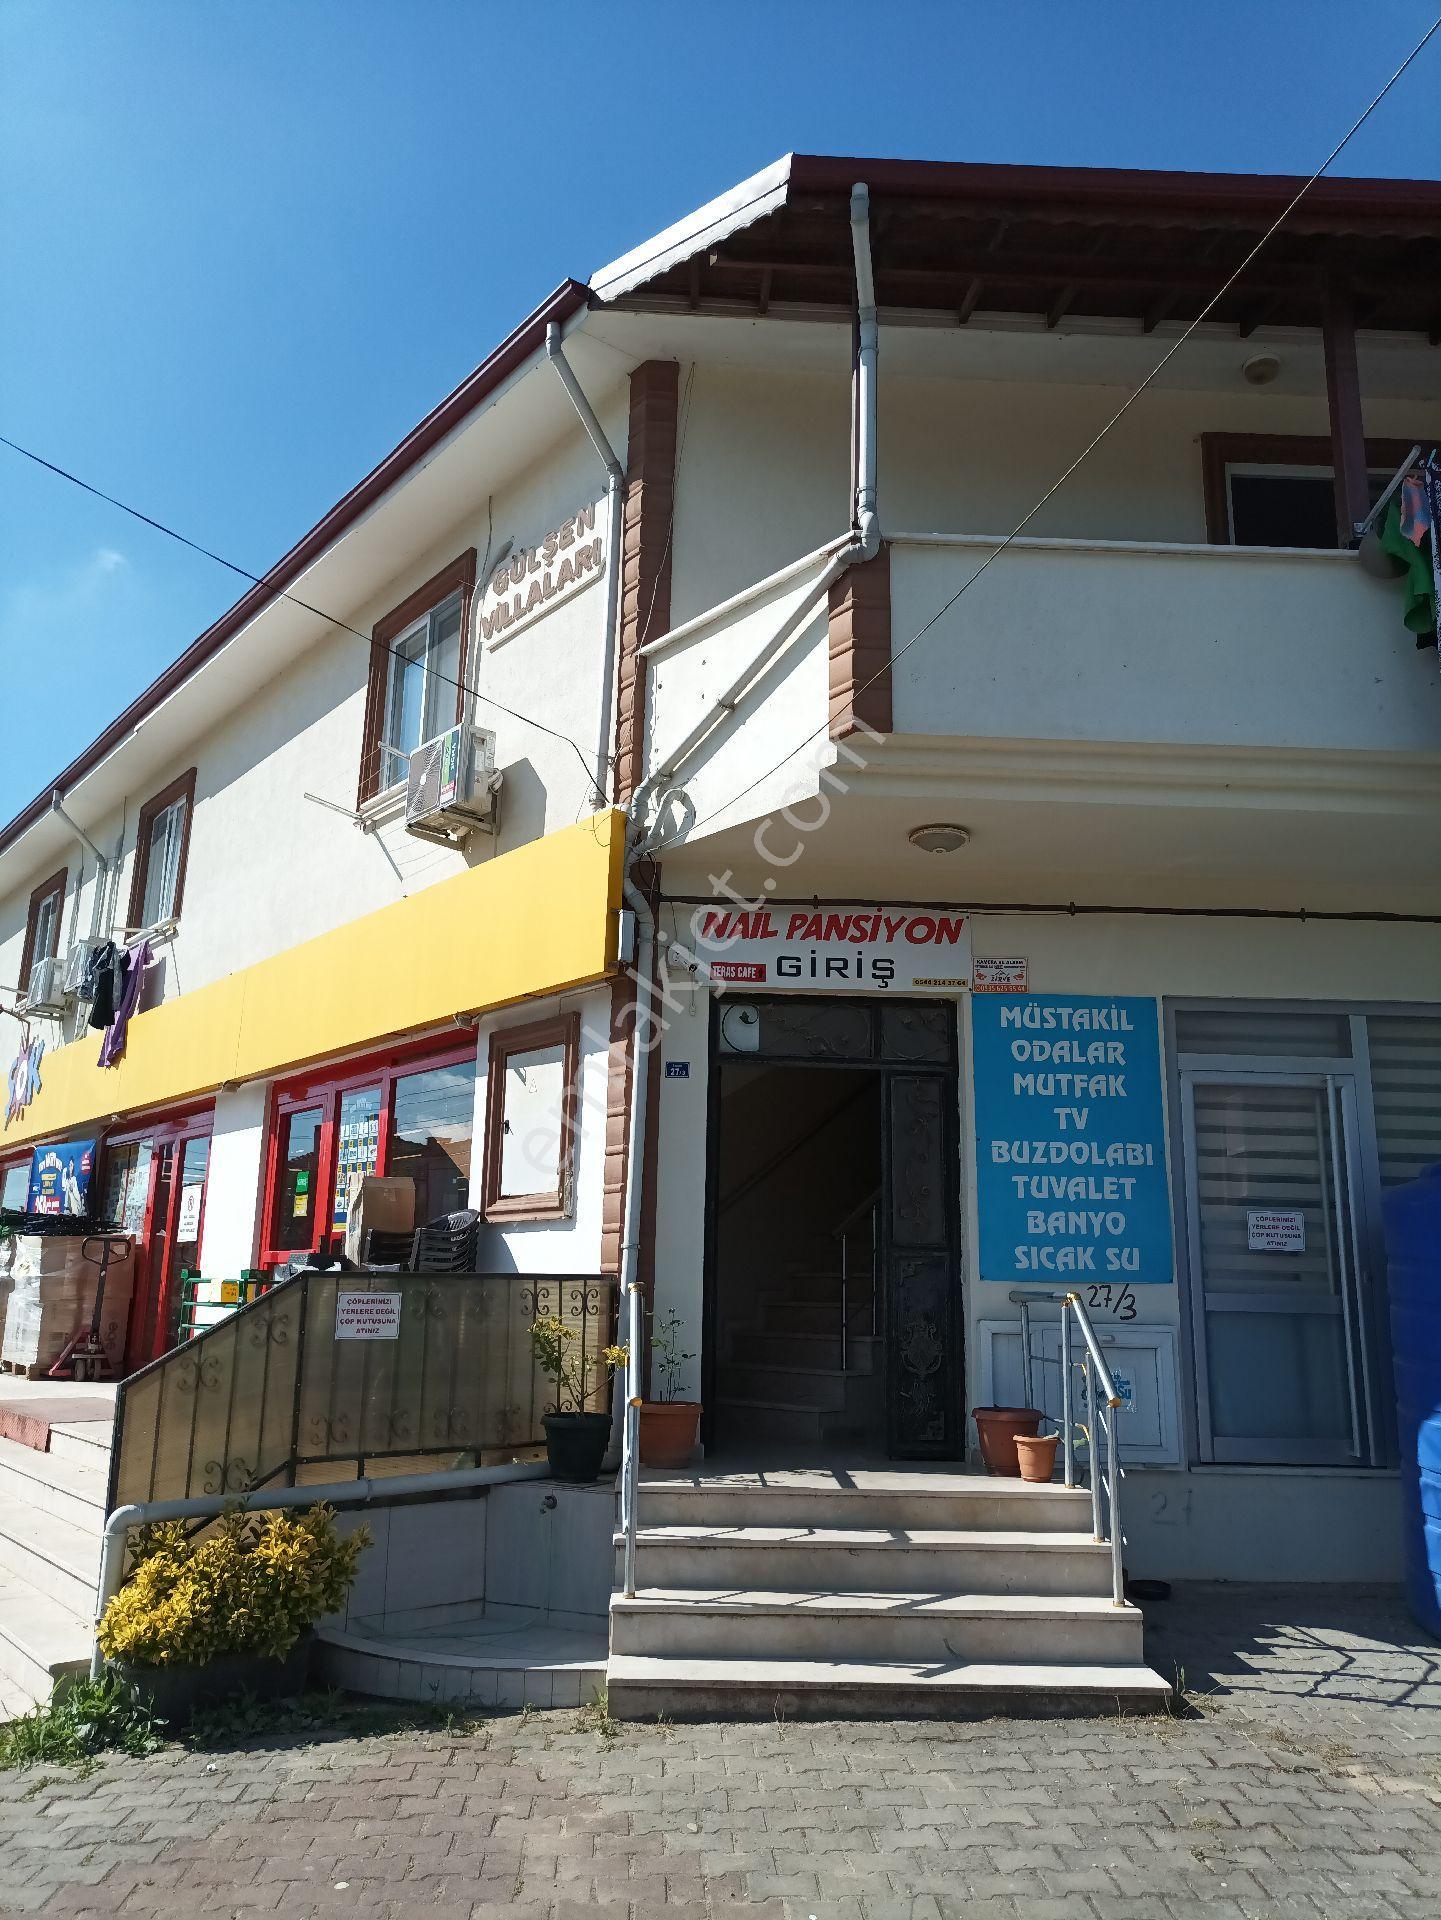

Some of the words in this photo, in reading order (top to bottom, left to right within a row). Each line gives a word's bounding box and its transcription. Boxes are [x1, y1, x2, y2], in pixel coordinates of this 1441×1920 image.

[492, 501, 596, 597] GÜLŞEN
[479, 536, 603, 641] VİLLALARI
[701, 906, 779, 940] NAİL
[785, 907, 965, 945] PANSİYON
[712, 965, 736, 978] TERAS
[737, 966, 757, 979] CAFE
[776, 950, 895, 989] GİRİŞ
[1000, 1002, 1135, 1031] MÜSTAKİL
[1011, 1039, 1127, 1066] ODALAR
[1013, 1073, 1128, 1099] MUTFAK
[1053, 1107, 1090, 1130] TV
[990, 1140, 1154, 1168] BUZDOLABI
[1011, 1175, 1137, 1202] TUVALET
[1026, 1210, 1127, 1238] BANYO
[1014, 1245, 1096, 1272] SICAK
[1105, 1247, 1141, 1271] SU
[1086, 1283, 1138, 1321] 27/3
